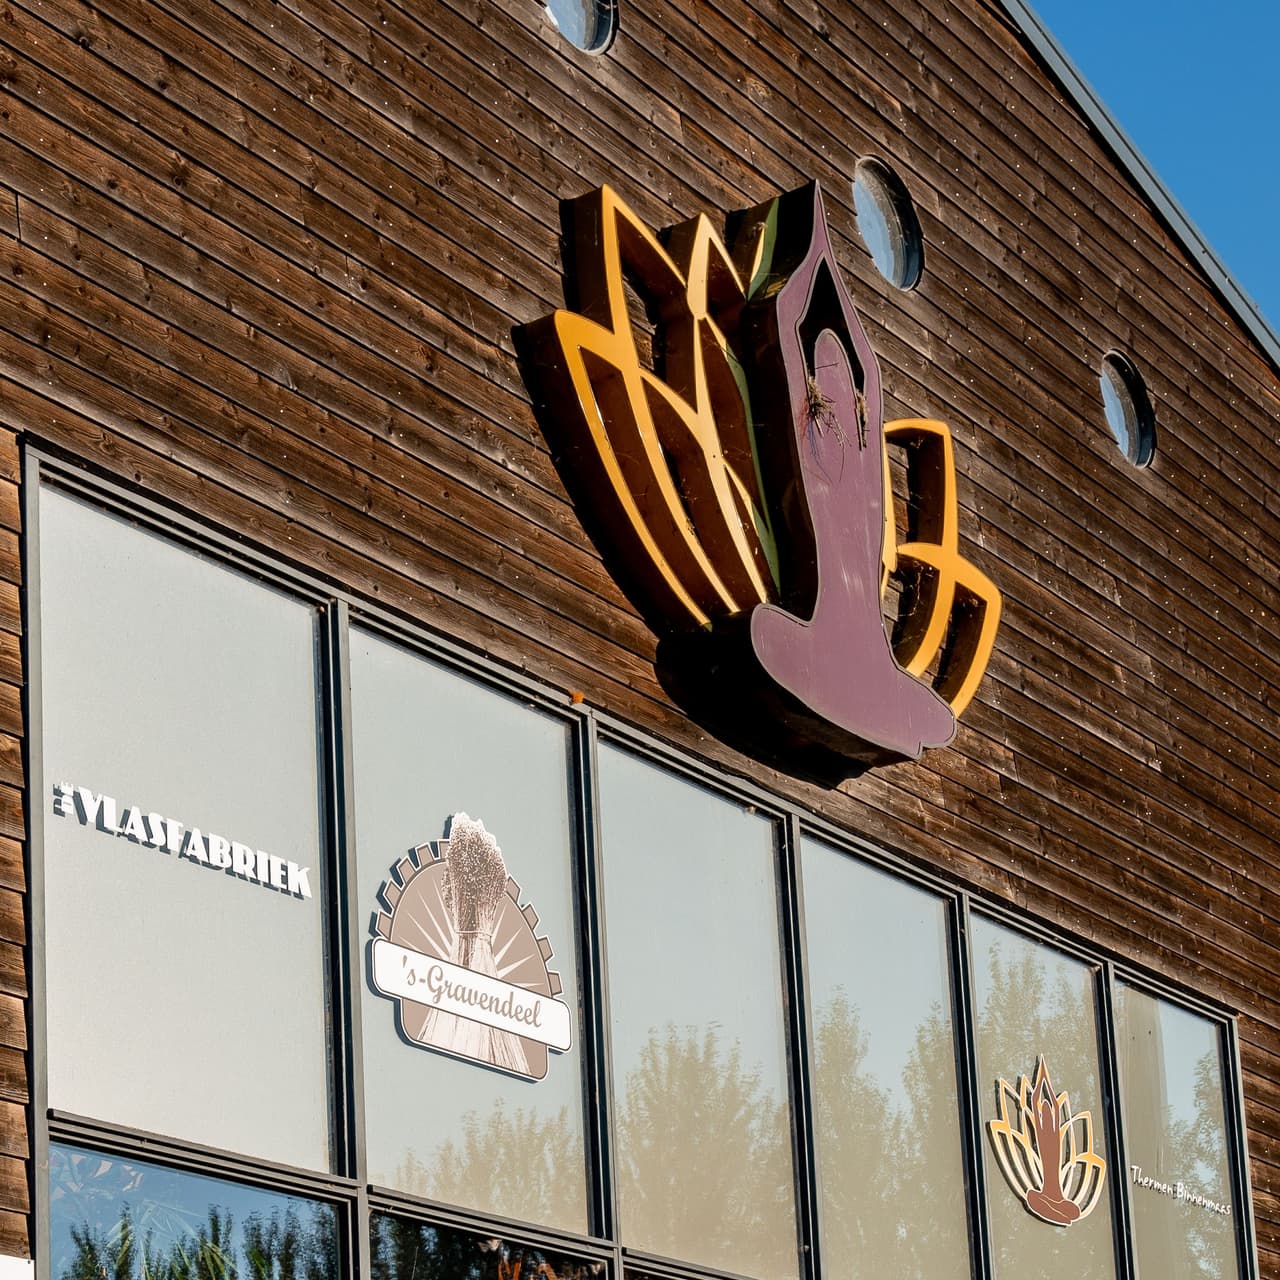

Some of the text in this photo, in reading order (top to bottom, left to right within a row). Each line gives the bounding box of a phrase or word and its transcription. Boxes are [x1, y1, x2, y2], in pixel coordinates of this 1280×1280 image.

[77, 785, 313, 899] VLASFABRIEK
[400, 954, 543, 1029] 's-Gravendeel
[1130, 1164, 1174, 1195] Thermen
